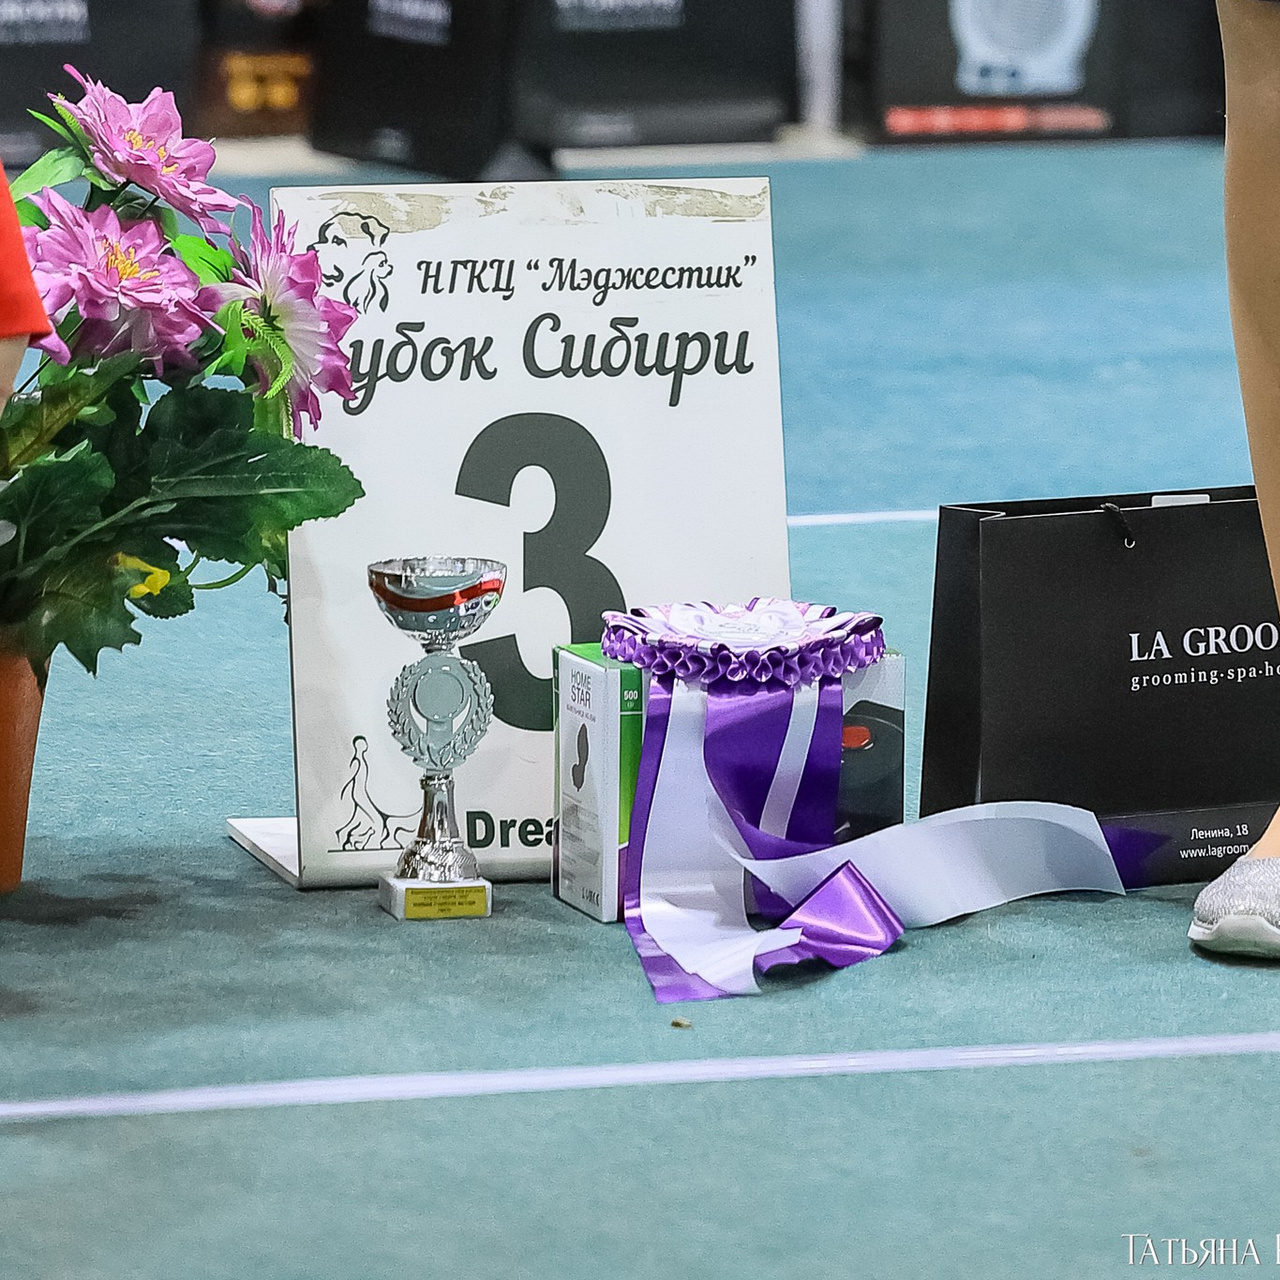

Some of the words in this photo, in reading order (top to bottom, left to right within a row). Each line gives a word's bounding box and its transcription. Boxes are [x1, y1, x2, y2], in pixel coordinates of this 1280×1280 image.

[417, 258, 515, 301] НГКЦ
[342, 321, 498, 416] убок
[523, 312, 754, 407] Сибири
[455, 412, 628, 731] 3
[1128, 630, 1173, 662] LA
[571, 668, 592, 692] HOME
[571, 685, 592, 709] STAR
[624, 690, 639, 701] 500
[1190, 827, 1234, 840] Ленина,
[1235, 824, 1249, 837] 18
